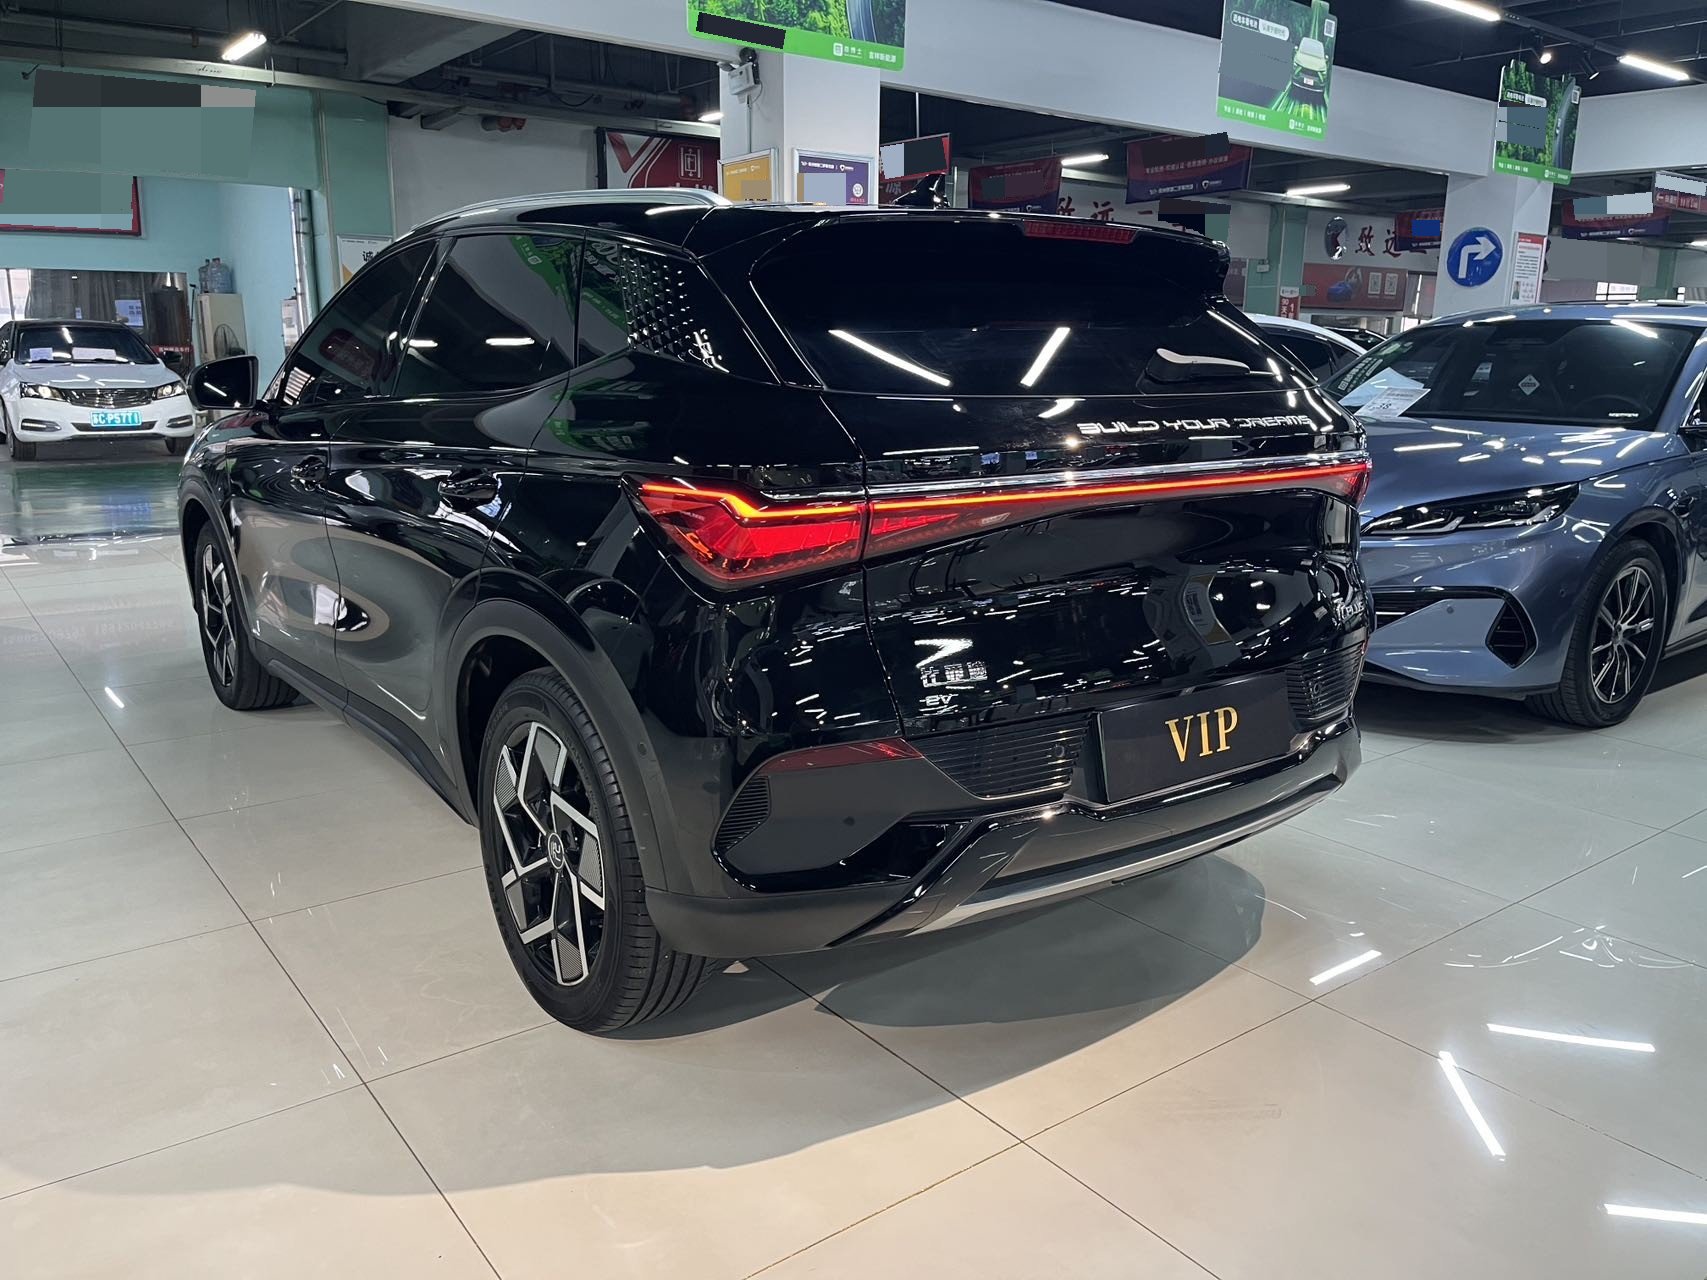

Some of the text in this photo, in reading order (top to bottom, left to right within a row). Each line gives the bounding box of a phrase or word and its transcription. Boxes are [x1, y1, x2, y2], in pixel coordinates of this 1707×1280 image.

[1077, 415, 1313, 434] BUILD YOUR DREAMS
[1165, 705, 1239, 763] VIP
